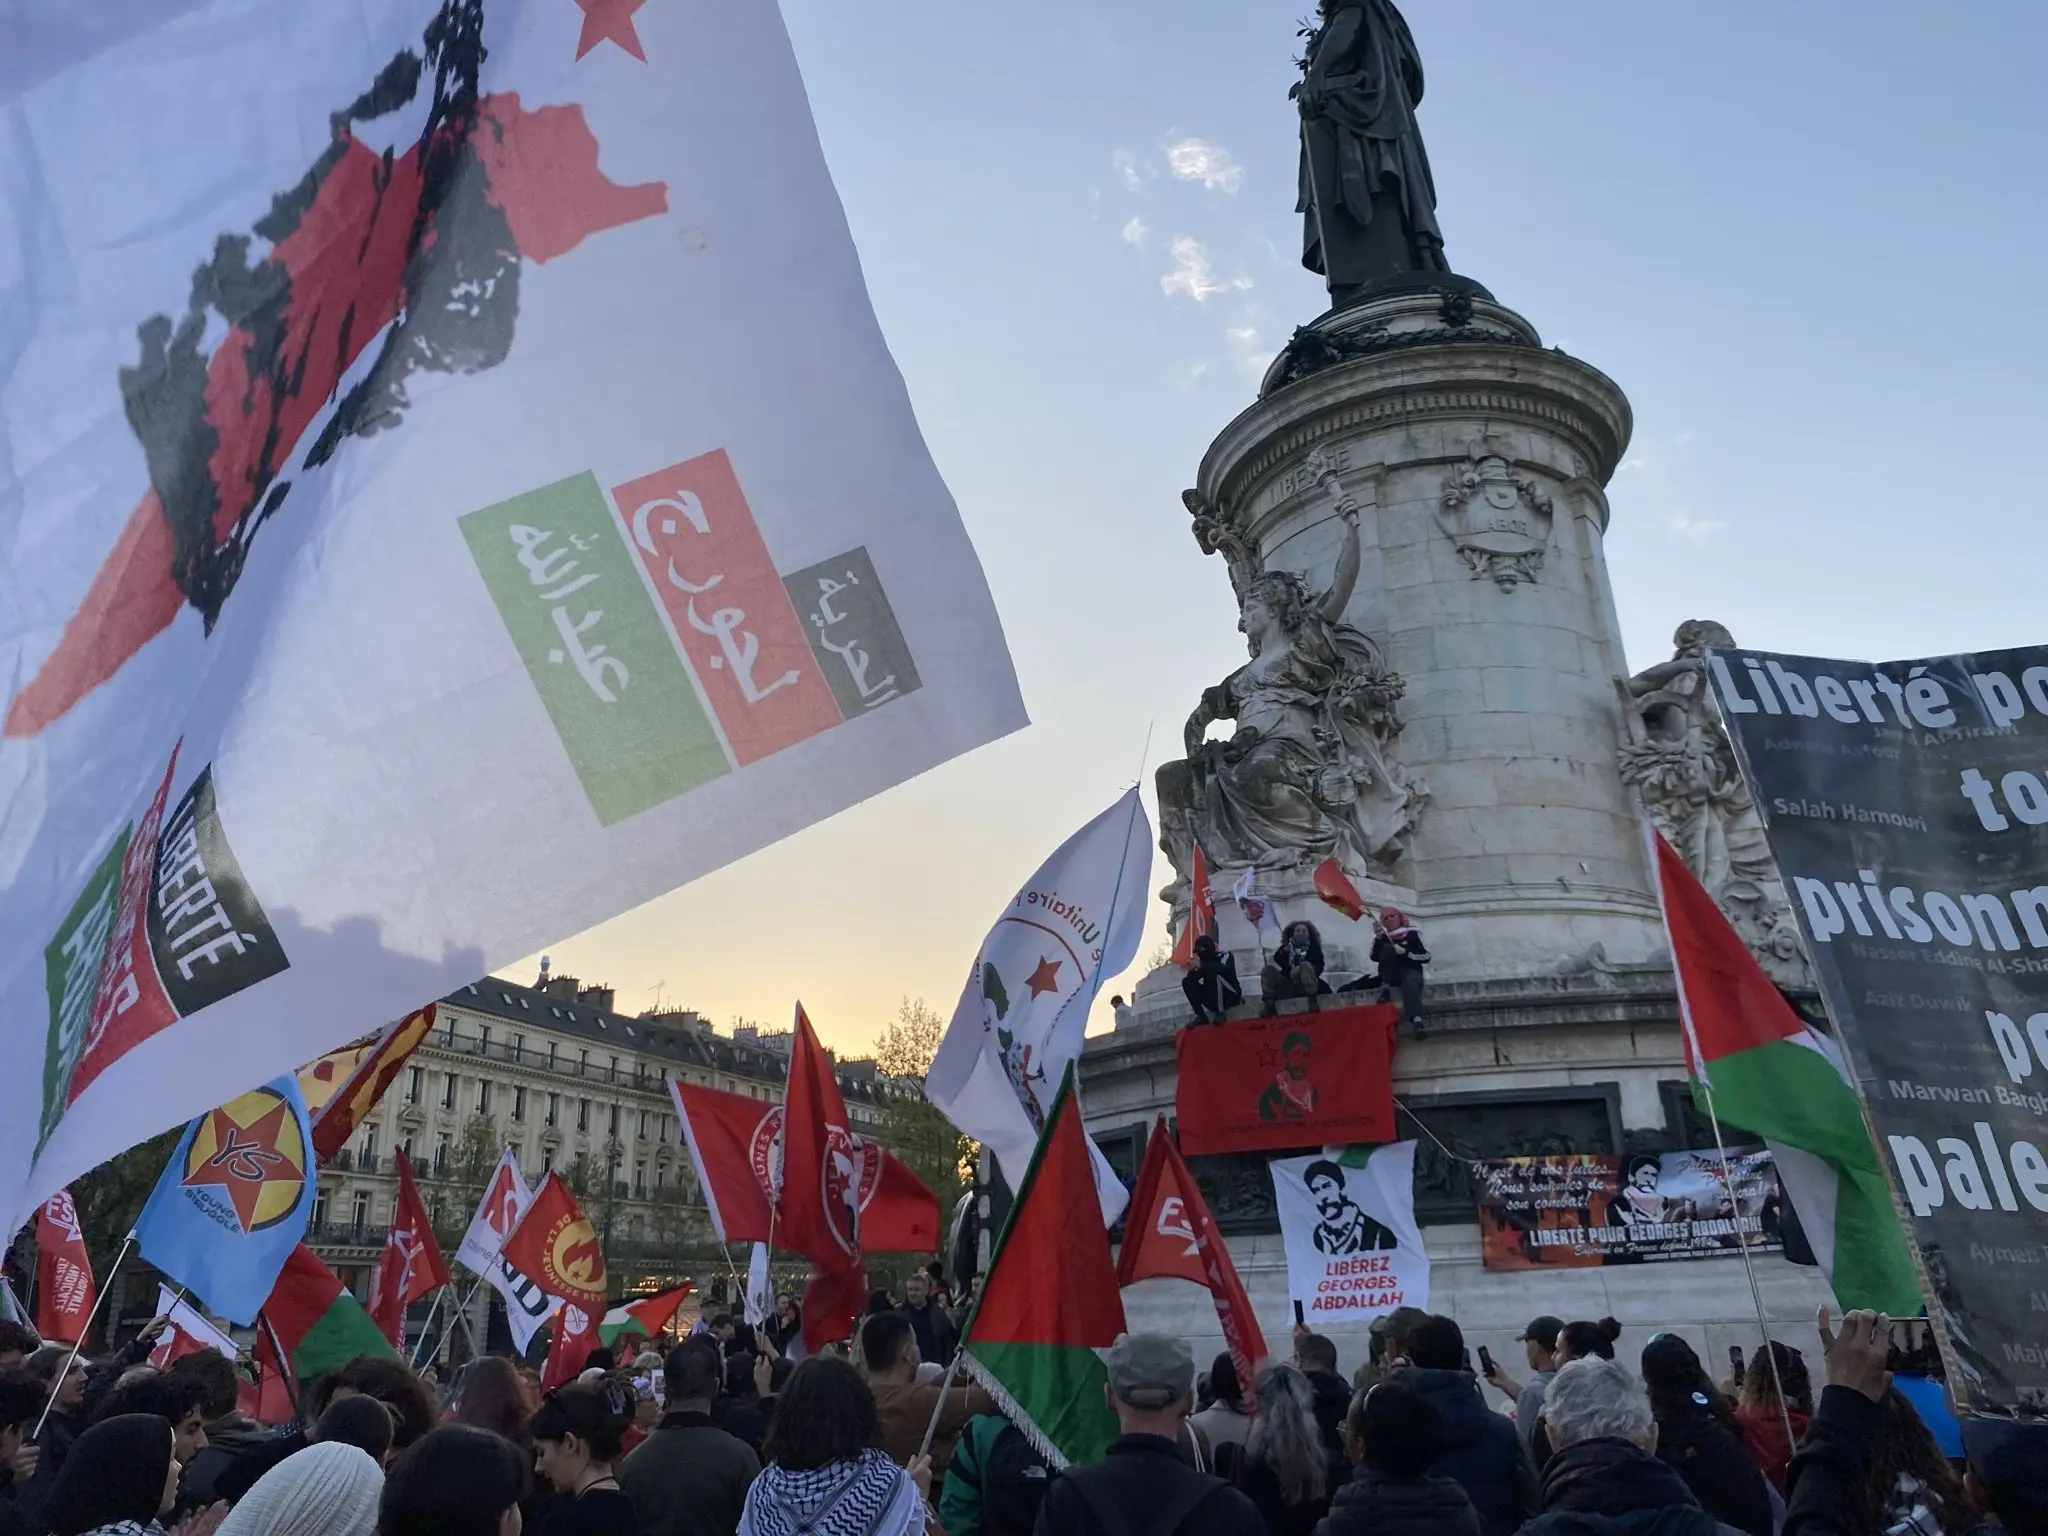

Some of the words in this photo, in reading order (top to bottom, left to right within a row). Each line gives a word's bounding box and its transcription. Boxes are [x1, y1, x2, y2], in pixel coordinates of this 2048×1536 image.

[631, 489, 802, 704] لجورج
[808, 569, 900, 709] الحرية
[1709, 655, 1958, 730] Liberté
[1773, 797, 1836, 820] Salah
[1841, 803, 1929, 834] Hamouri
[1960, 766, 2048, 833] to
[156, 796, 258, 982] LIBERTÉ
[1793, 868, 2048, 953] prisonn
[1920, 947, 1984, 971] Eddine
[1888, 1078, 1992, 1104] Marwan
[211, 1128, 282, 1181] YS
[1887, 1121, 2048, 1217] pale
[196, 1187, 236, 1219] YOUNG
[1486, 1178, 1525, 1195] Nous
[184, 1189, 242, 1234] STRUGGLE
[1505, 1199, 1530, 1212] son
[1529, 1225, 1586, 1247] LIBERTÉ
[1588, 1226, 1627, 1245] POUR
[1629, 1222, 1689, 1241] GEORGES
[1325, 1254, 1391, 1276] LIBÉREZ
[1969, 1240, 2041, 1266] Aymen
[1317, 1275, 1398, 1293] GEORGES
[1311, 1291, 1404, 1312] ABDALLAH
